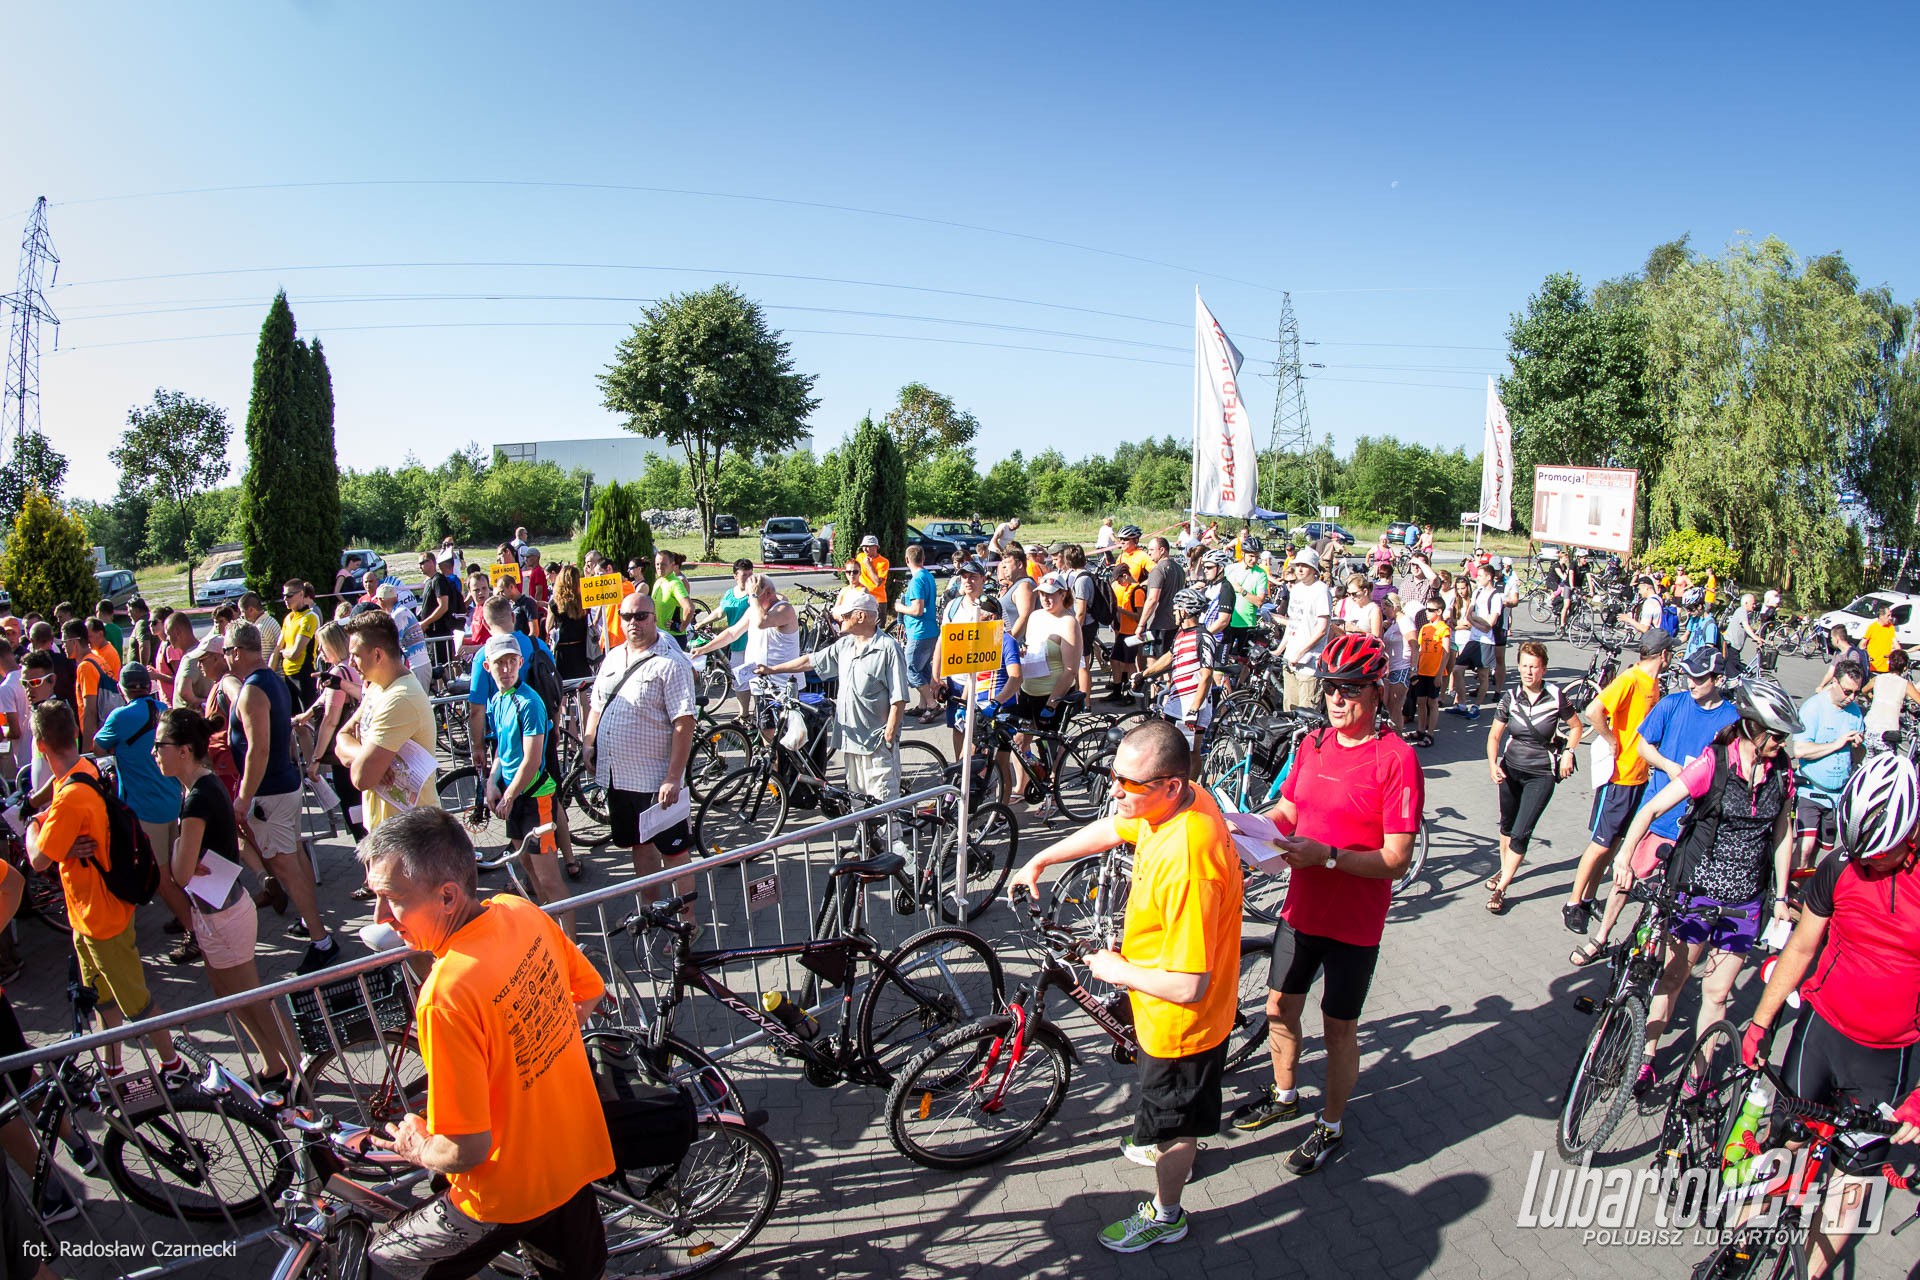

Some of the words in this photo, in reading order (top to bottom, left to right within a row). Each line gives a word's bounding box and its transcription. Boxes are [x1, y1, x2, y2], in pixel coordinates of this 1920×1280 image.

[1223, 381, 1237, 424] RED
[1221, 433, 1235, 502] BLACK
[1538, 471, 1585, 484] Promocja!
[583, 580, 593, 588] od
[595, 578, 617, 587] E2001
[584, 594, 594, 602] do
[596, 591, 618, 601] E4000
[949, 630, 964, 641] od
[968, 630, 980, 640] E1
[948, 653, 963, 665] do
[966, 651, 997, 665] E2000
[492, 986, 510, 1006] XXII
[1069, 985, 1126, 1034] MERIDA
[721, 997, 803, 1045] KANDS
[126, 1076, 152, 1090] SLS
[38, 1130, 52, 1174] LEAER
